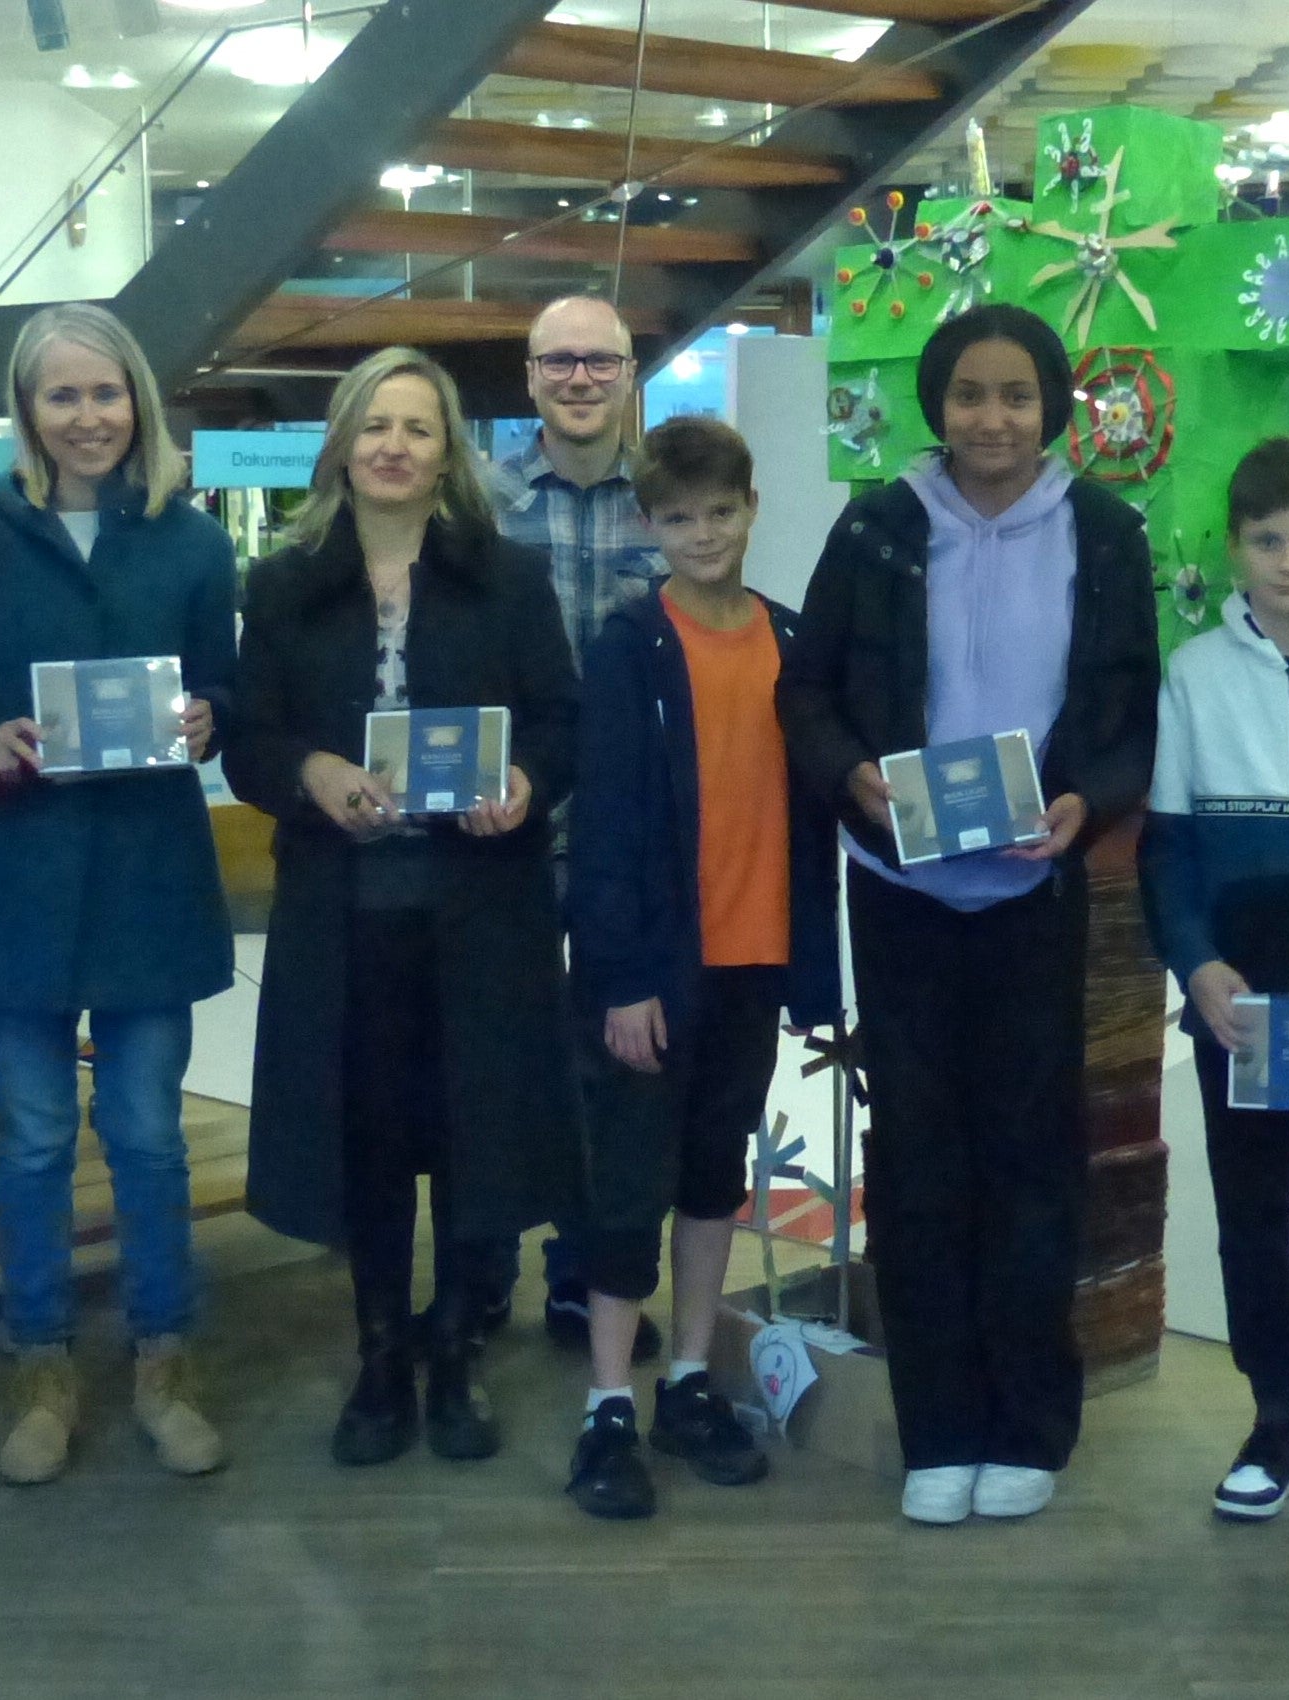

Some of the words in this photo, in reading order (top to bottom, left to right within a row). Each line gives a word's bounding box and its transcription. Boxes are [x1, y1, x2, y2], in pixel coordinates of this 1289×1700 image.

[231, 451, 316, 467] Dokumenta
[1227, 801, 1254, 812] STOP
[1255, 801, 1282, 812] PLAY
